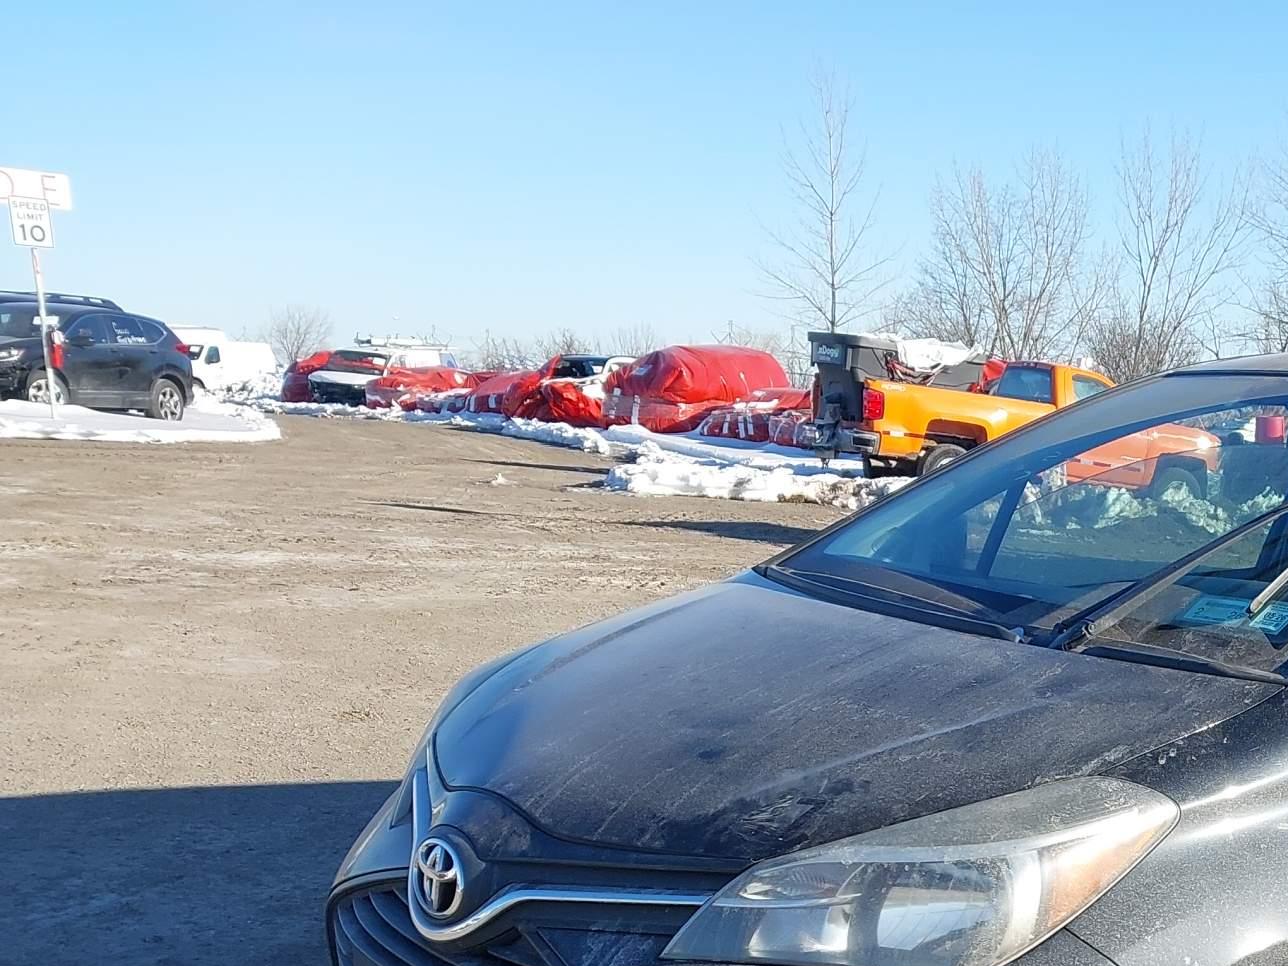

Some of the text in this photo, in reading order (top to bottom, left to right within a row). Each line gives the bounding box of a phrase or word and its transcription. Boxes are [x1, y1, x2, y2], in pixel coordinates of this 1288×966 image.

[11, 200, 47, 212] SPEED
[16, 211, 44, 221] LIMIT
[19, 223, 46, 243] 10
